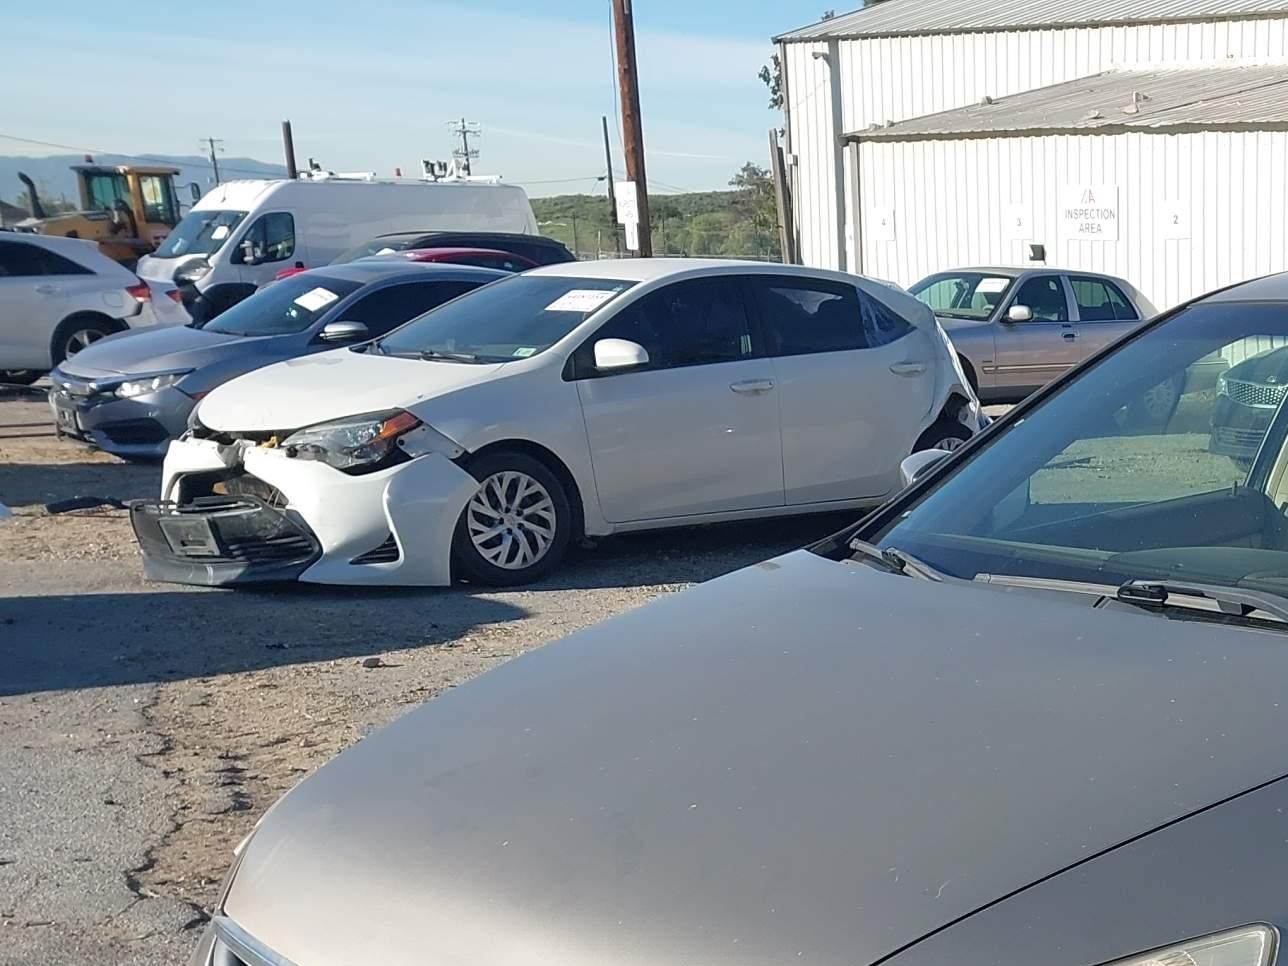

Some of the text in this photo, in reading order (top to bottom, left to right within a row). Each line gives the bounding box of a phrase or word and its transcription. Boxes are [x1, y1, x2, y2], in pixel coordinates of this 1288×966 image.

[1065, 208, 1115, 220] INSPECTION
[1173, 213, 1180, 225] 2
[1079, 222, 1103, 234] AREA
